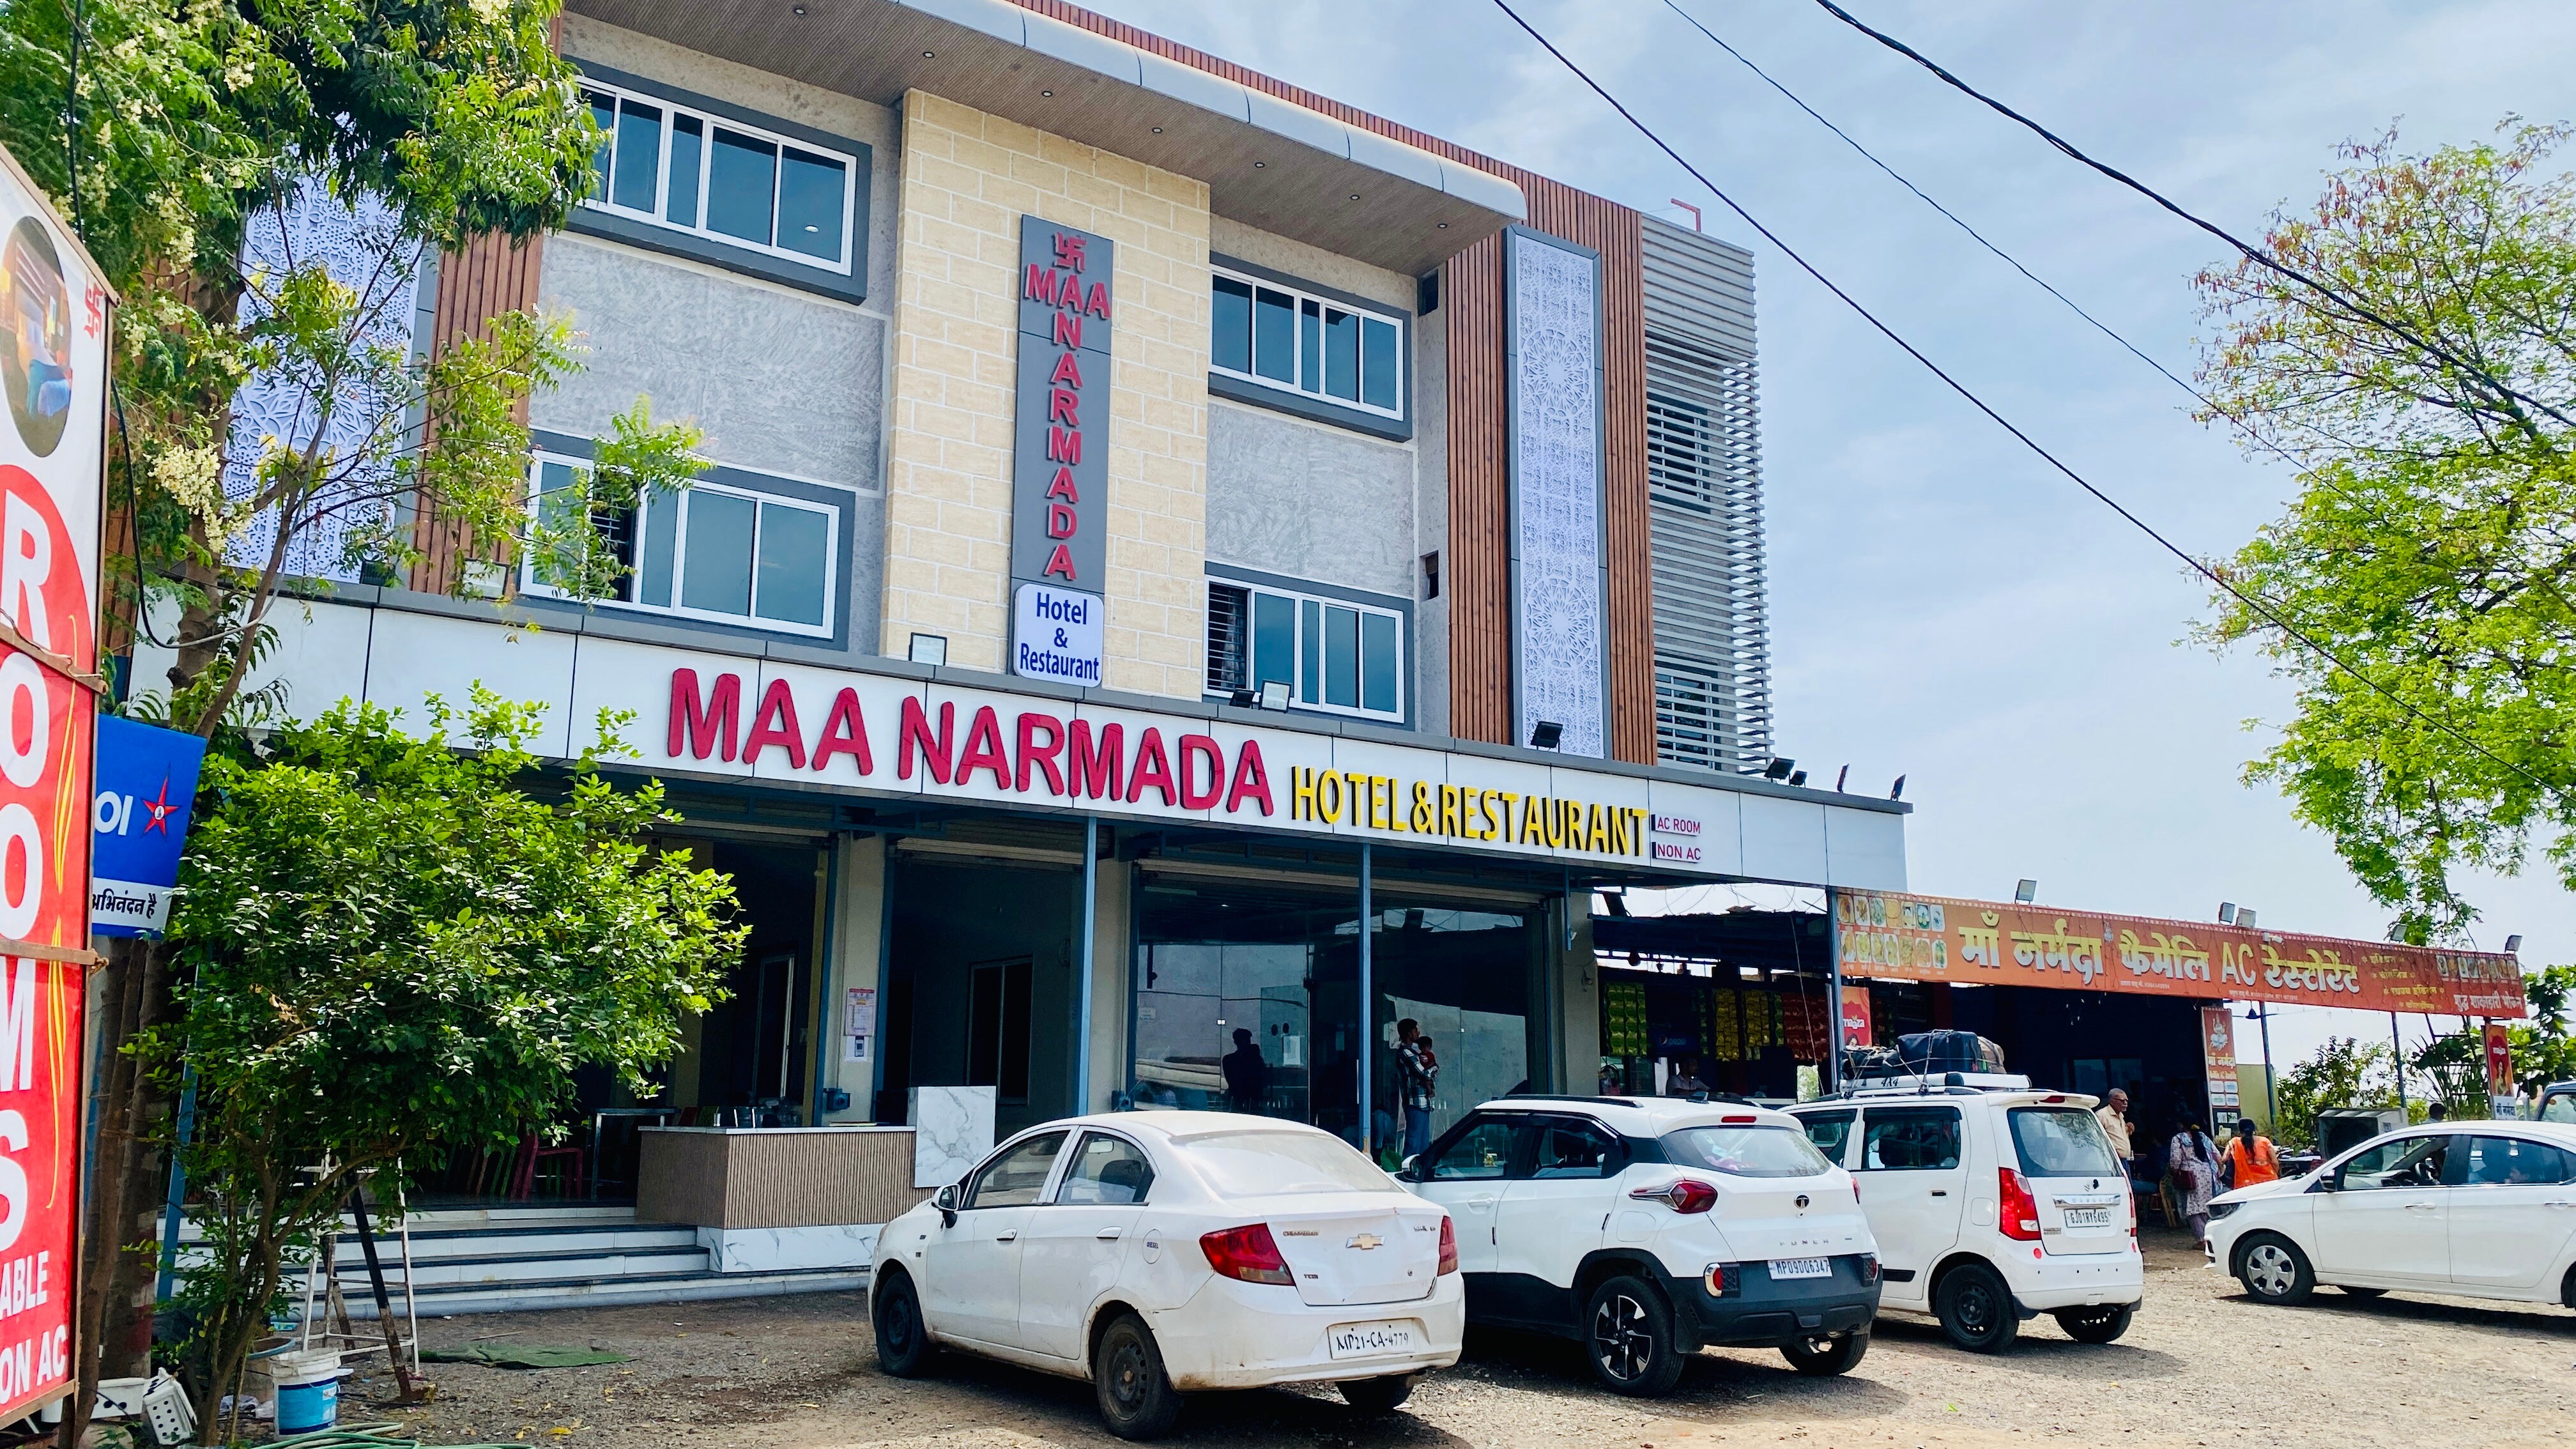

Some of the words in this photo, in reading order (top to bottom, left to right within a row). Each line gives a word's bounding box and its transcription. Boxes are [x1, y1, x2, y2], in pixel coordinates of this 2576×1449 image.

[1025, 263, 1111, 319] MAA
[1044, 312, 1082, 581] NARMADA
[1036, 592, 1087, 625] Hotel
[1054, 627, 1068, 648] &
[1020, 643, 1100, 681] Restaurant
[667, 668, 873, 776] MAA
[898, 695, 1275, 817] NARMADA
[1657, 816, 1670, 830] AC
[1673, 818, 1701, 834] ROOM
[1657, 843, 1682, 859] NON
[1686, 847, 1701, 861] AC
[146, 893, 157, 919] है
[1958, 909, 2000, 968] माँ
[2010, 917, 2104, 985] नर्मदा
[2221, 940, 2257, 986] AC
[36, 1324, 67, 1387] AC
